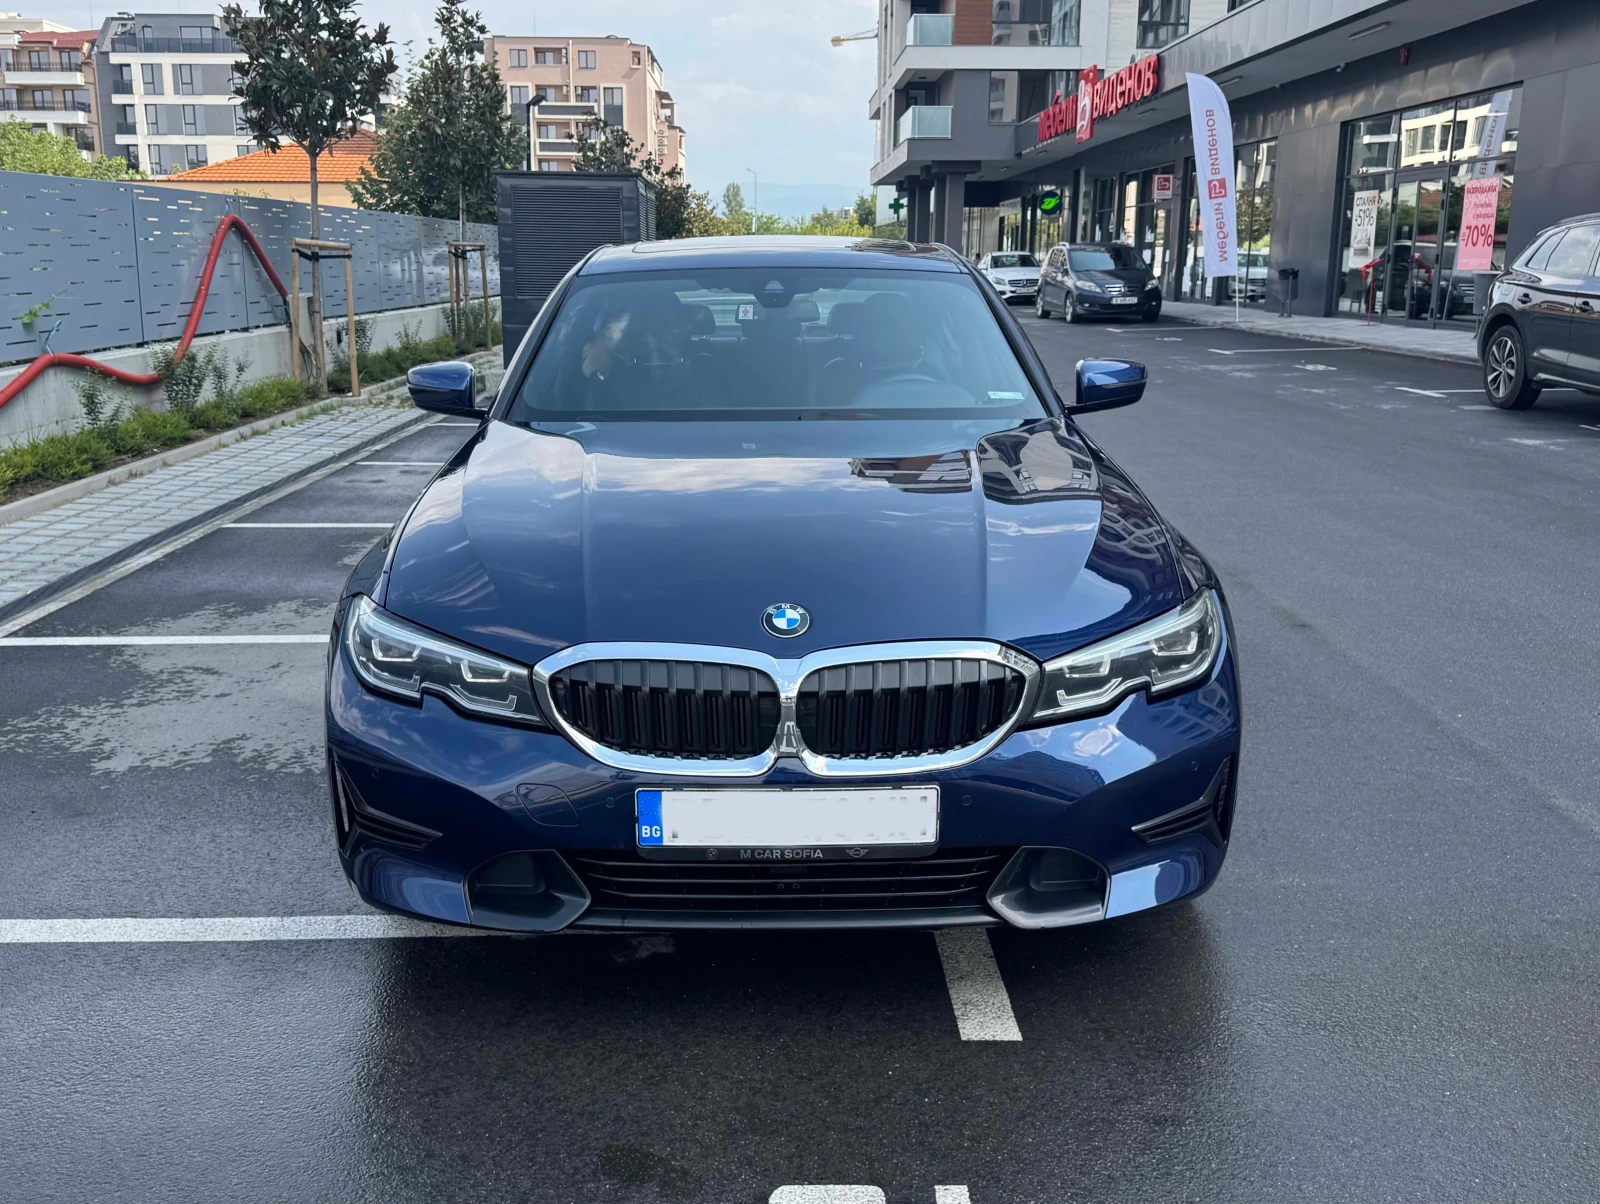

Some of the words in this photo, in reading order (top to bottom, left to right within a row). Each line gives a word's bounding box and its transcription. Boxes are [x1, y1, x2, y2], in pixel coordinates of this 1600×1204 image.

[1038, 89, 1079, 142] мебели
[1093, 54, 1159, 118] виденов
[1461, 223, 1493, 248] -70%
[768, 603, 805, 615] BMW
[641, 825, 661, 838] BG
[740, 849, 751, 859] M
[754, 849, 781, 859] CAR
[784, 849, 824, 859] SOFIA
